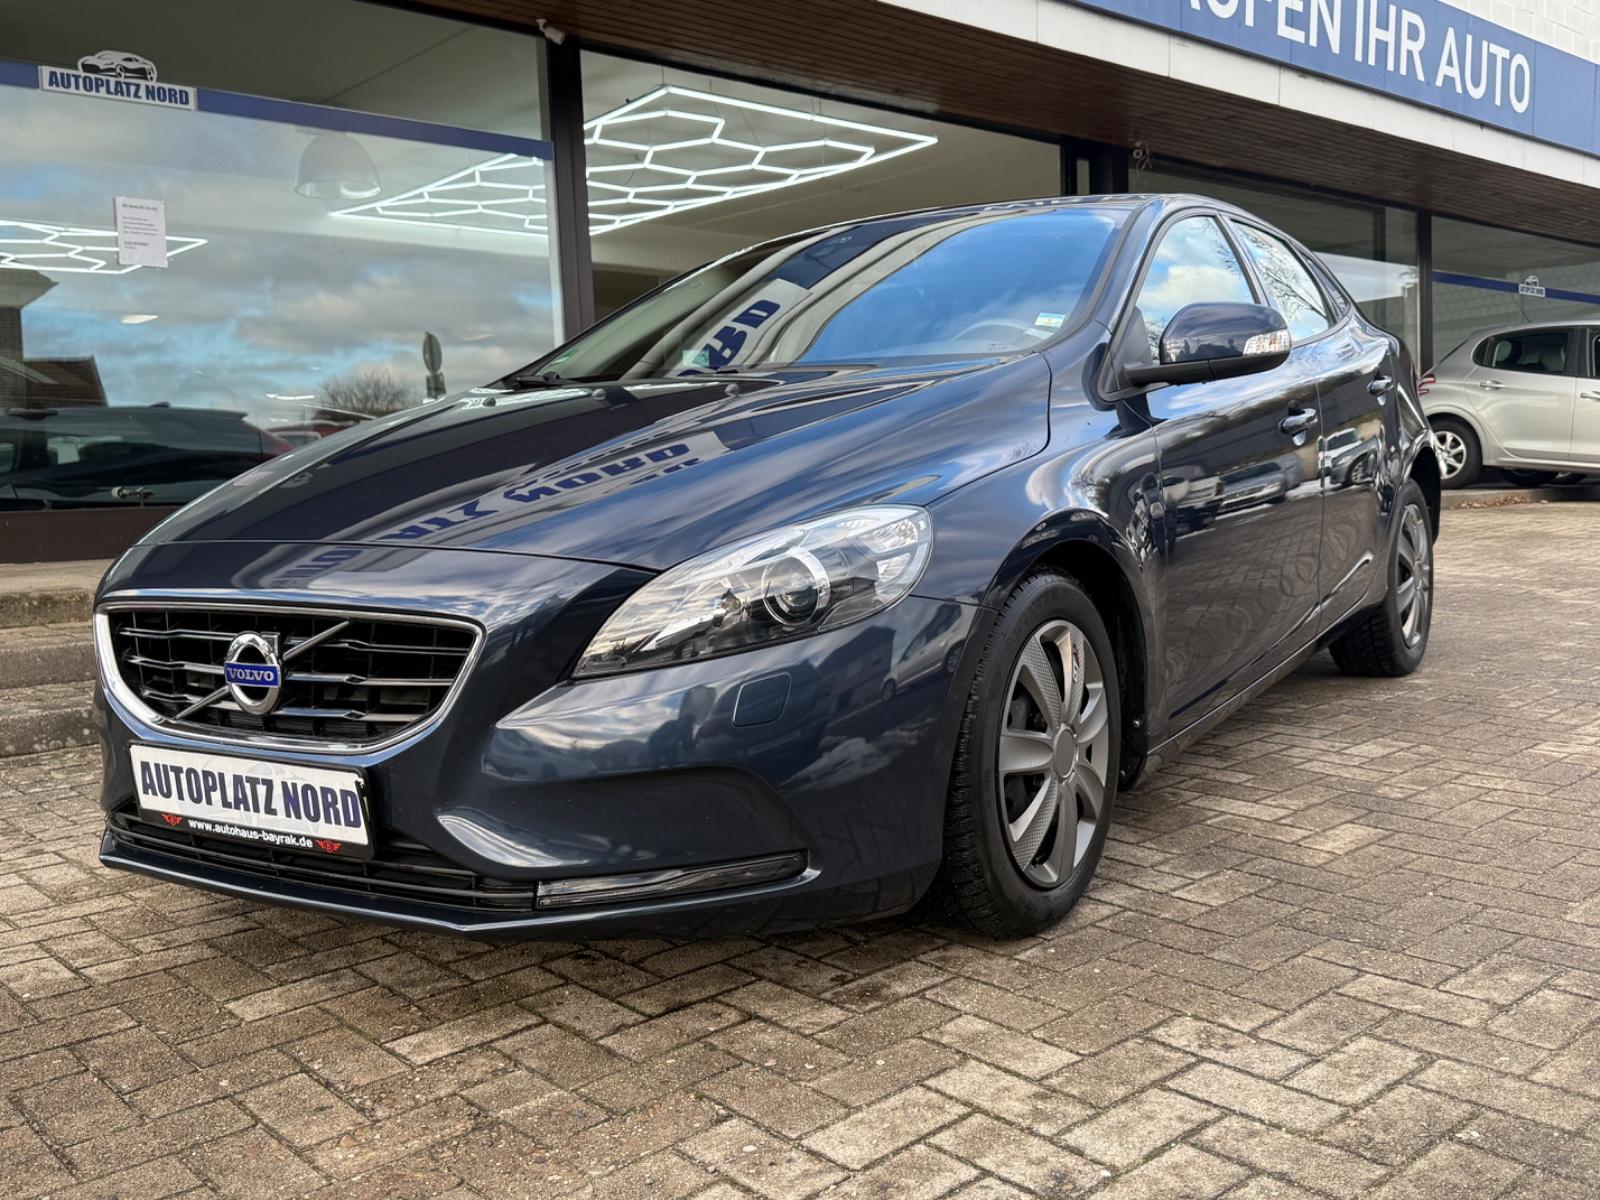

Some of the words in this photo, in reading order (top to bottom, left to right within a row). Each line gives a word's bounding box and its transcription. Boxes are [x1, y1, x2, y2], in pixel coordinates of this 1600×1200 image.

[1355, 0, 1425, 82] IHR
[1435, 27, 1531, 113] AUTO
[48, 71, 142, 99] AUTOPLATZ
[146, 84, 190, 106] NORD
[227, 667, 274, 682] VOLVO
[140, 761, 278, 817] AUTOPLATZ
[281, 780, 362, 829] NORD
[188, 818, 313, 848] www.autohaus-bayrak.de
